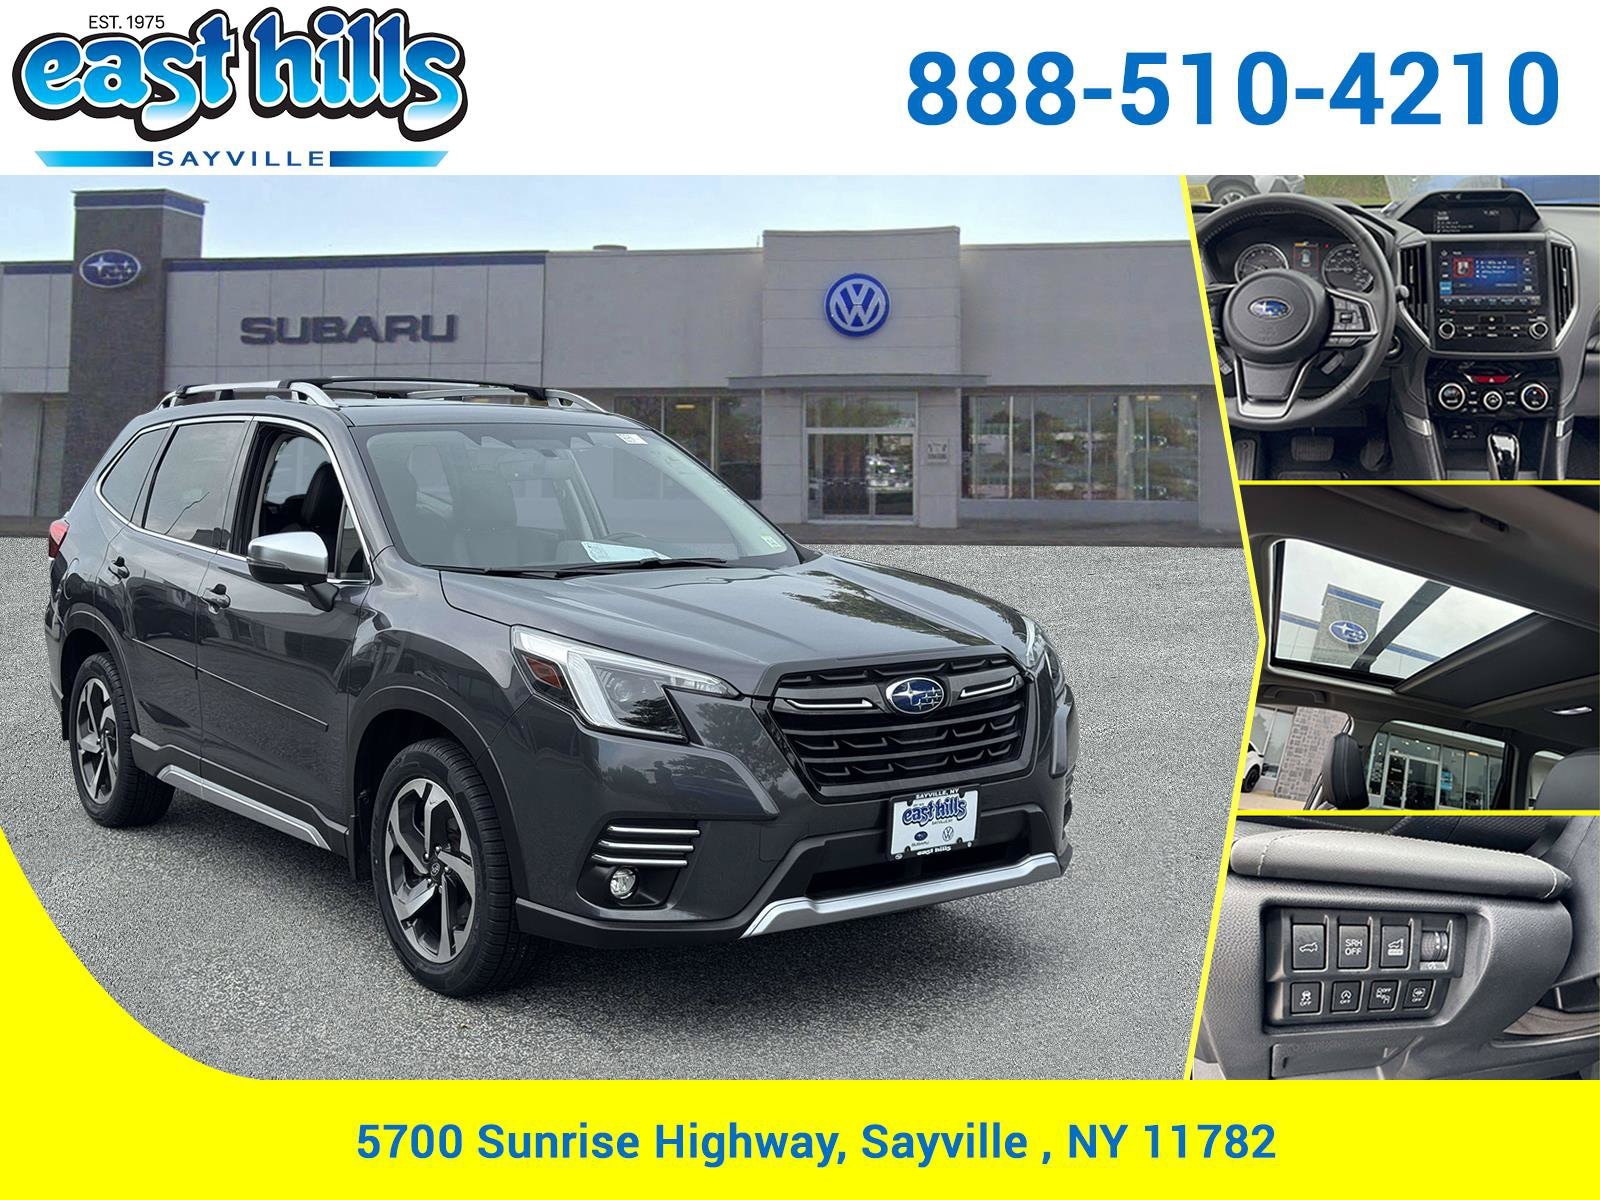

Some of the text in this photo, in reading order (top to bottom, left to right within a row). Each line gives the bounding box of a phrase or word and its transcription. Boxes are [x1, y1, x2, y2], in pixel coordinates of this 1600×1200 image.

[240, 314, 457, 345] SUBARU
[902, 796, 967, 827] east hills
[1345, 938, 1363, 947] SRH
[1345, 948, 1362, 956] OFF
